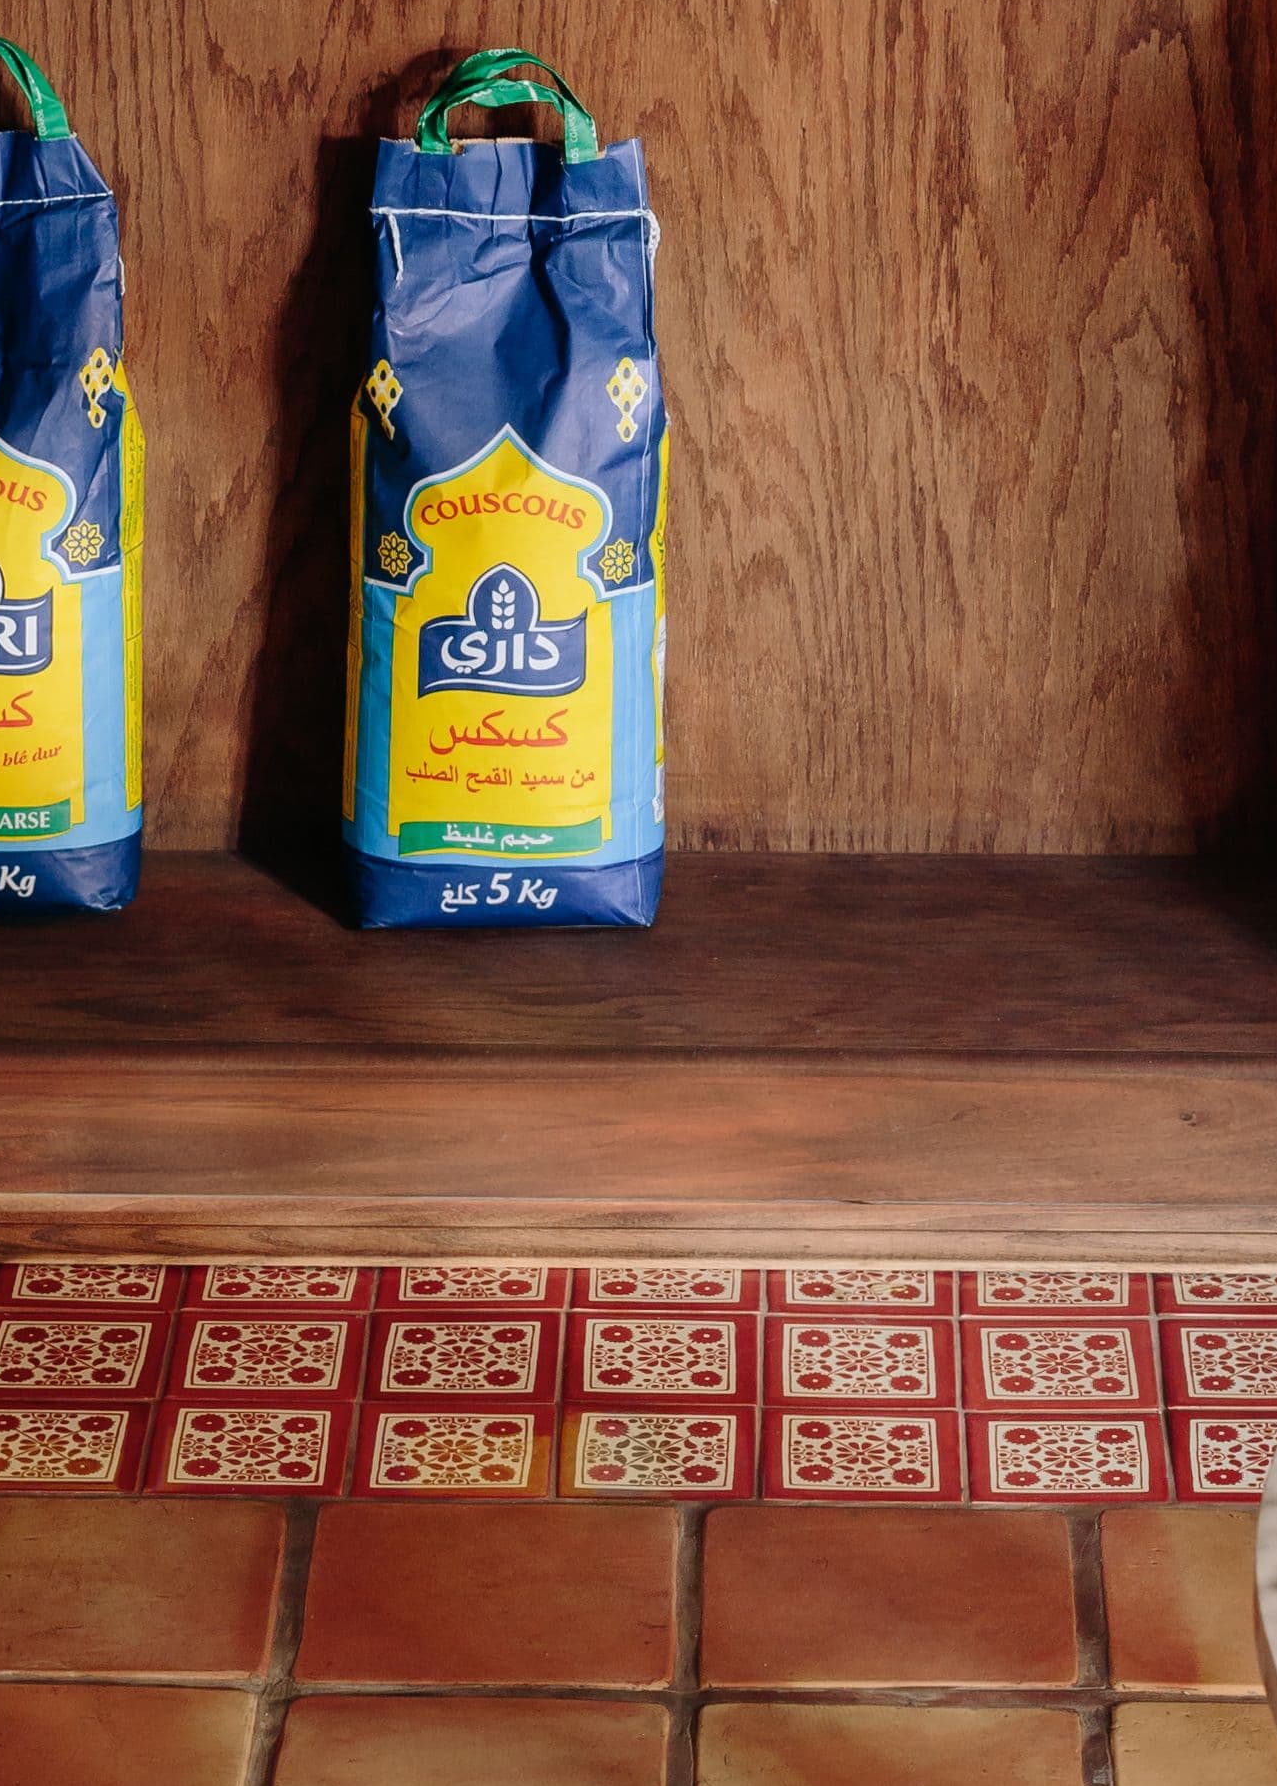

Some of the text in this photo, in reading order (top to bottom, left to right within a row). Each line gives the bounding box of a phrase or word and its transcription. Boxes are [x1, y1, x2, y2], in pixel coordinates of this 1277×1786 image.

[441, 630, 560, 676] داري
[429, 709, 569, 755] كسكس
[3, 747, 27, 767] blé
[32, 745, 63, 763] dur
[405, 761, 595, 793] من سميد القمح الصلب
[441, 823, 554, 851] حجم غليظ
[440, 872, 559, 913] كلغ 5 Kg
